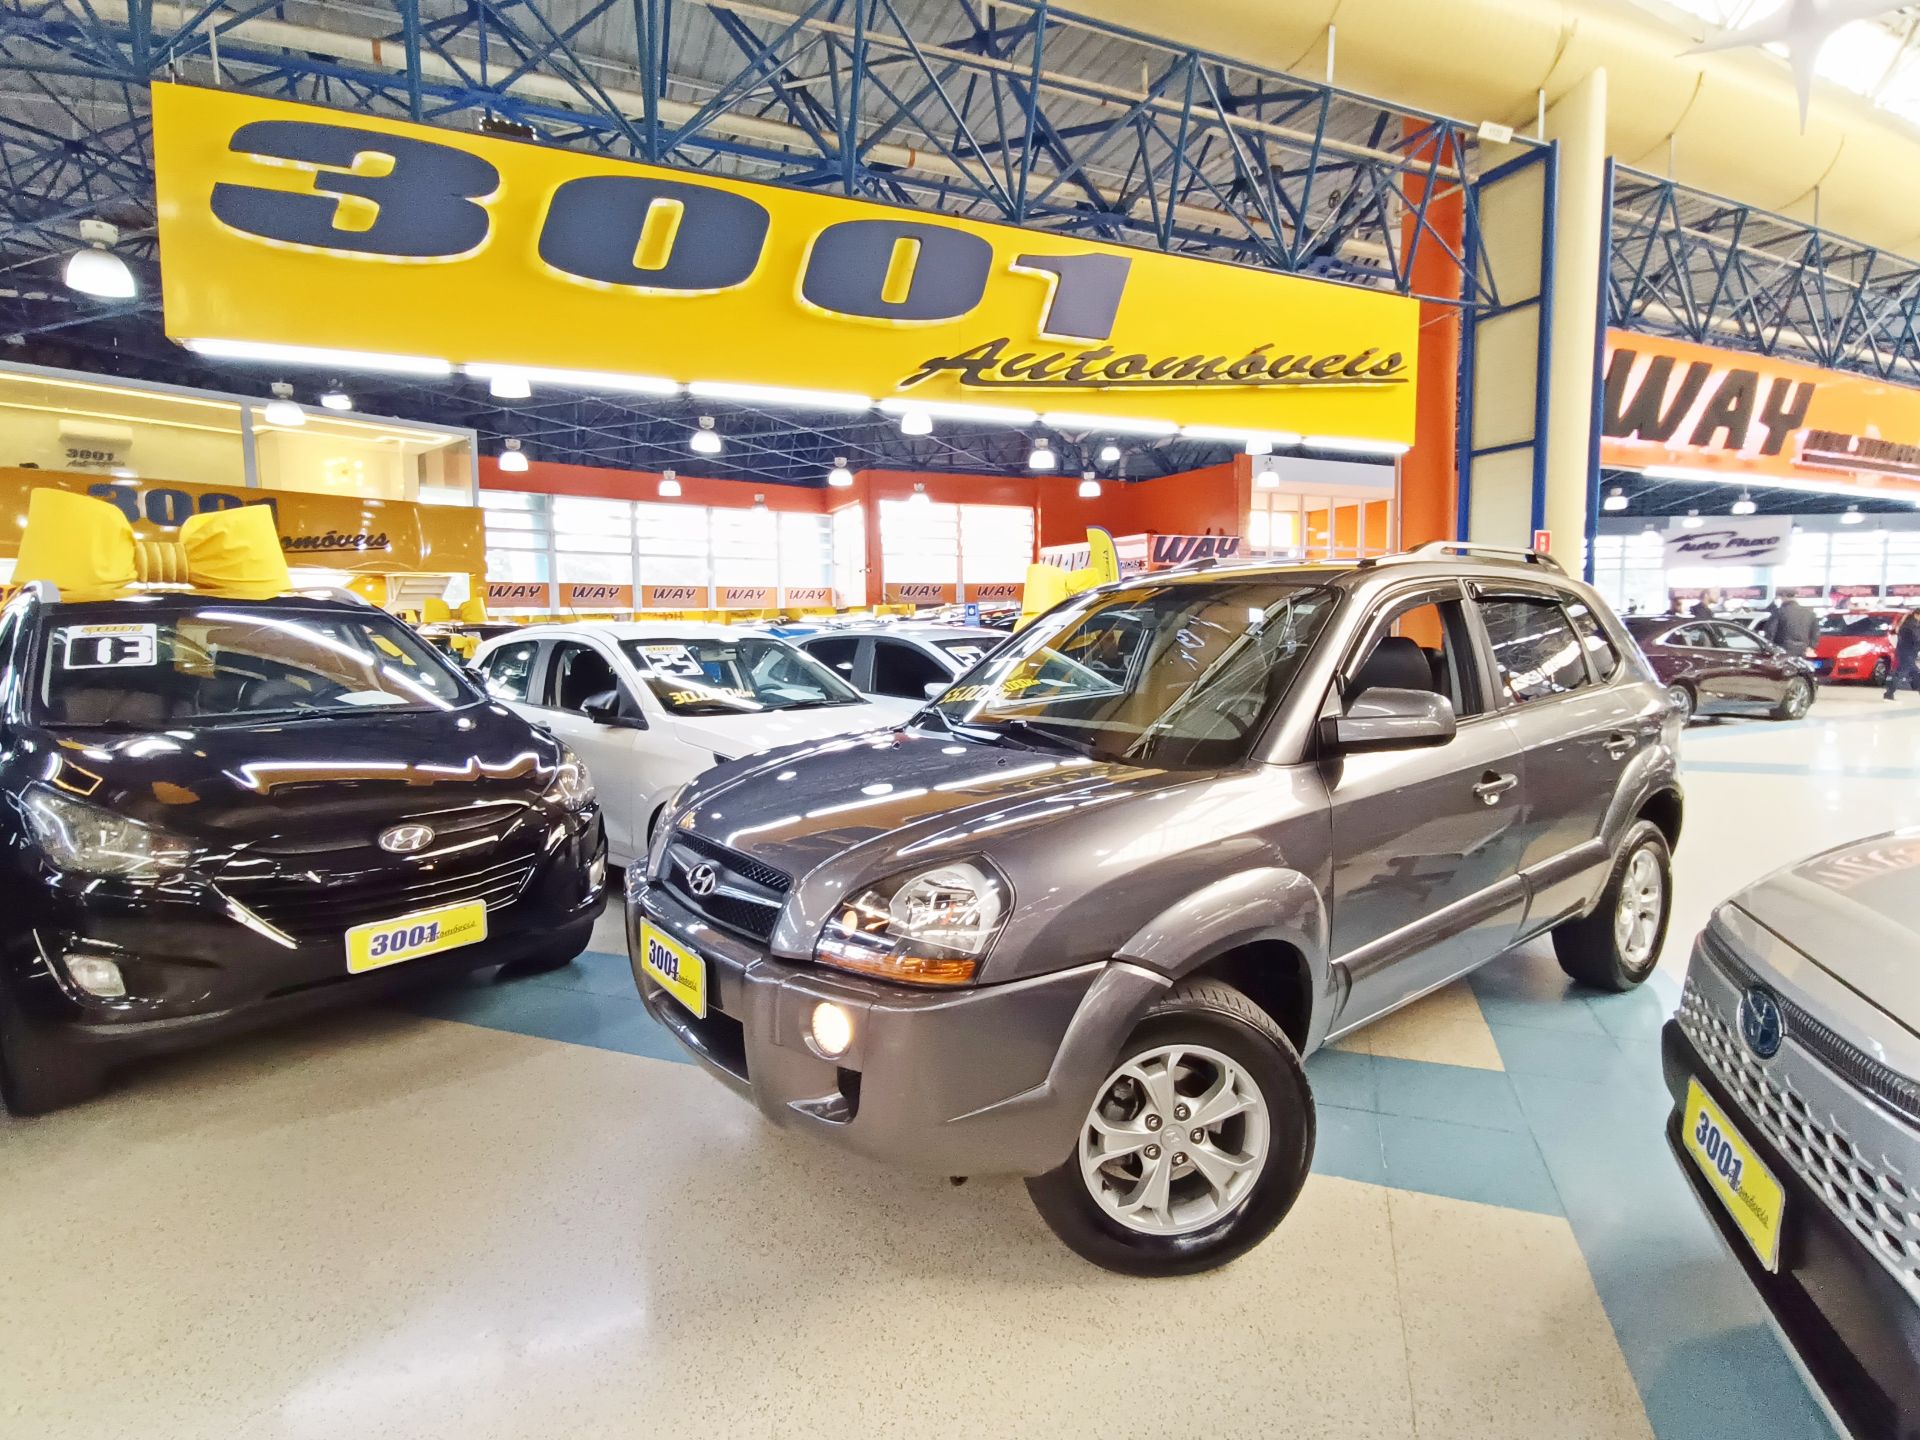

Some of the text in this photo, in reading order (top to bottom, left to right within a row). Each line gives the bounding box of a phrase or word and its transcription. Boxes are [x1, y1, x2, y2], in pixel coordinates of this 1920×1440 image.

[209, 118, 1132, 340] 3001
[901, 337, 1409, 387] Automóveis
[1602, 348, 1816, 456] WAY
[281, 531, 390, 550] omóveis
[1153, 536, 1241, 564] WAY
[1676, 535, 1780, 552] Auto Fluxo
[489, 585, 541, 598] WAY
[572, 586, 620, 598] WAY
[653, 588, 697, 599] WAY
[727, 588, 766, 600] WAY
[789, 588, 827, 600] WAY
[900, 585, 942, 596] WAY
[977, 585, 1017, 596] WAY
[650, 654, 696, 676] 25
[371, 921, 439, 957] 3001
[649, 939, 679, 982] 3001
[1696, 1110, 1743, 1192] 3001
